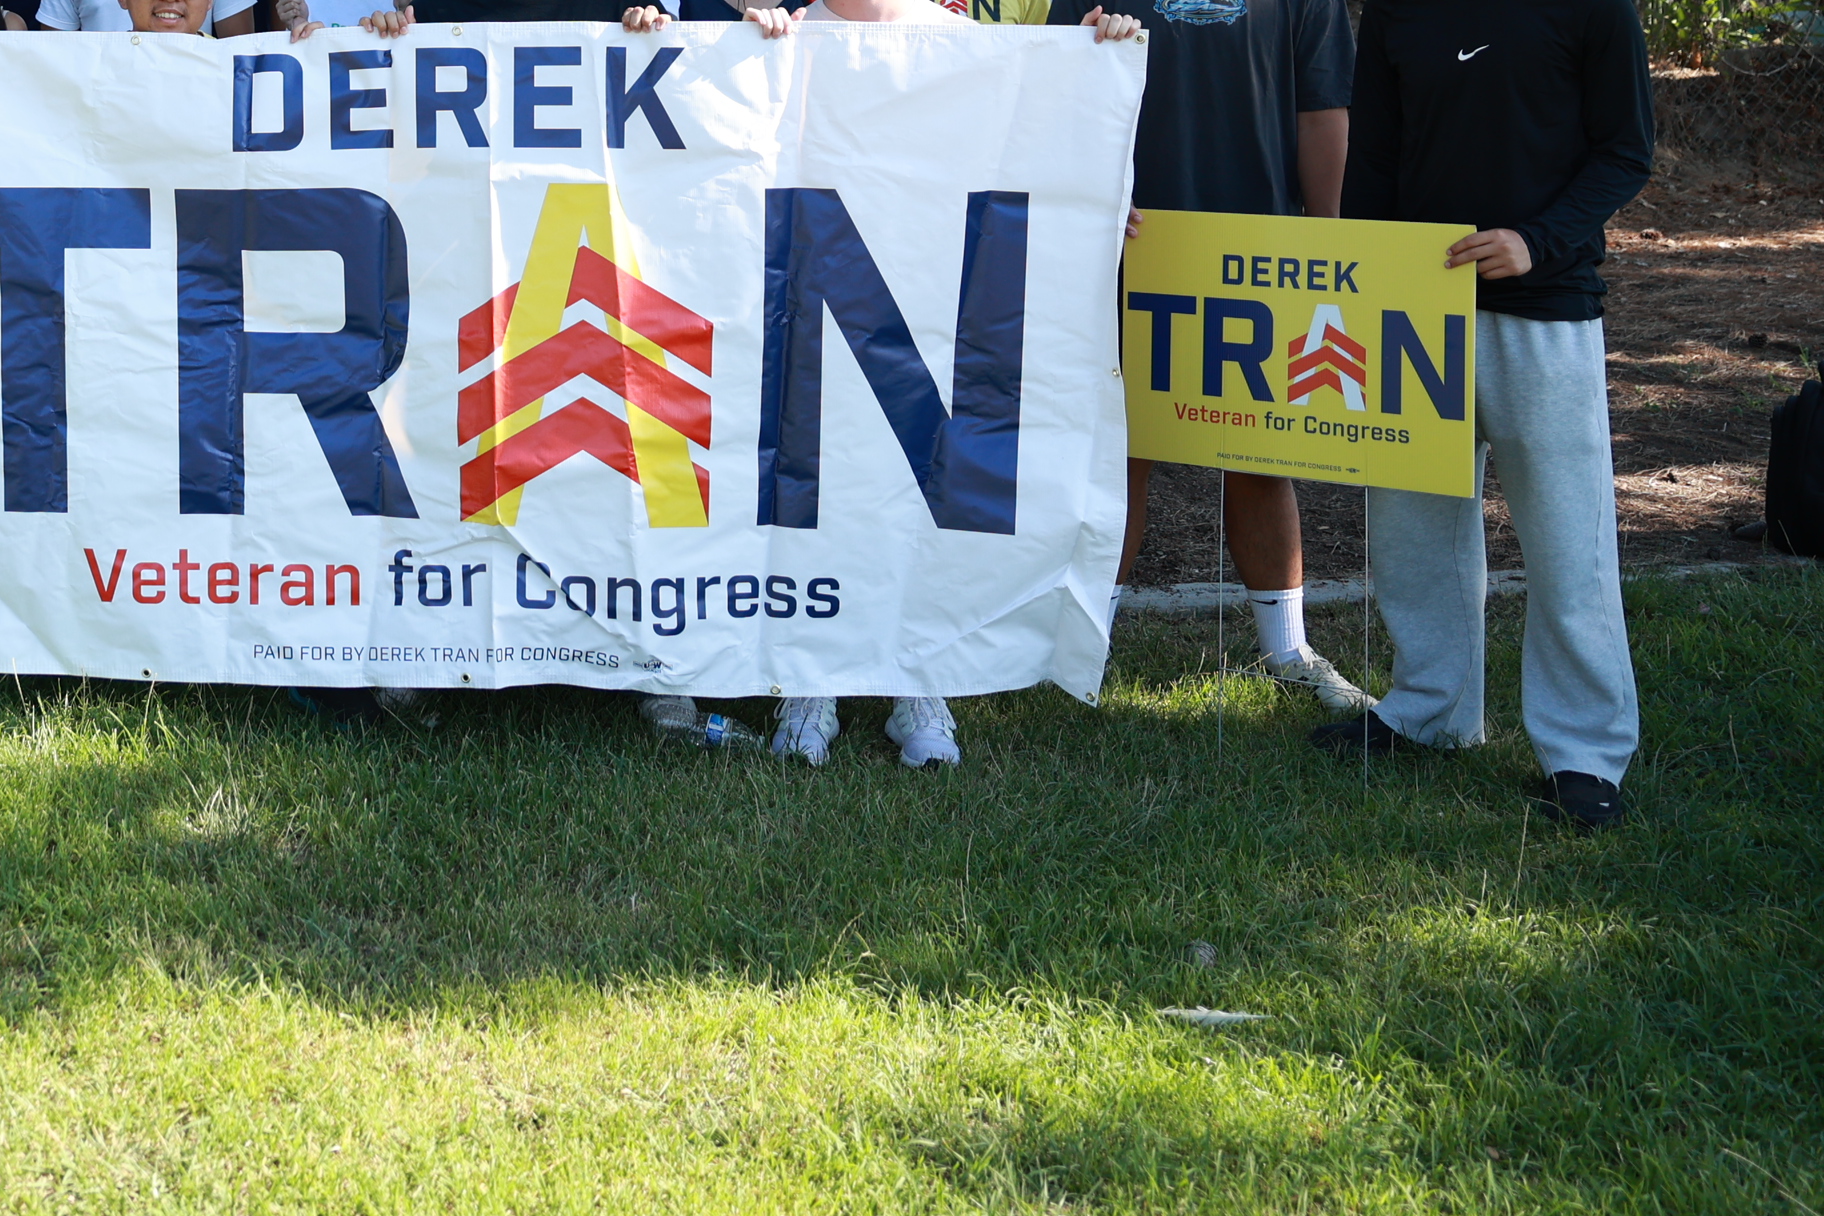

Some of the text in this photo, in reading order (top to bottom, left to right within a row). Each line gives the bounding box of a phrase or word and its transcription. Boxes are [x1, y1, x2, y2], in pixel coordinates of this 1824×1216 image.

[232, 45, 686, 151] DEREK
[1222, 254, 1359, 294] DEREK
[1127, 291, 1466, 421] TRAN
[1174, 402, 1410, 444] Veteran for Congress
[1231, 453, 1245, 461] FOR
[1254, 456, 1275, 464] DEREK
[1276, 458, 1293, 467] TRAN
[1294, 460, 1307, 468] FOR
[1307, 462, 1342, 472] CONGRESS
[84, 548, 842, 637] Veteran for Congress
[253, 644, 619, 669] PAID FOR BY DEREK TRAN FOR CONGRESS
